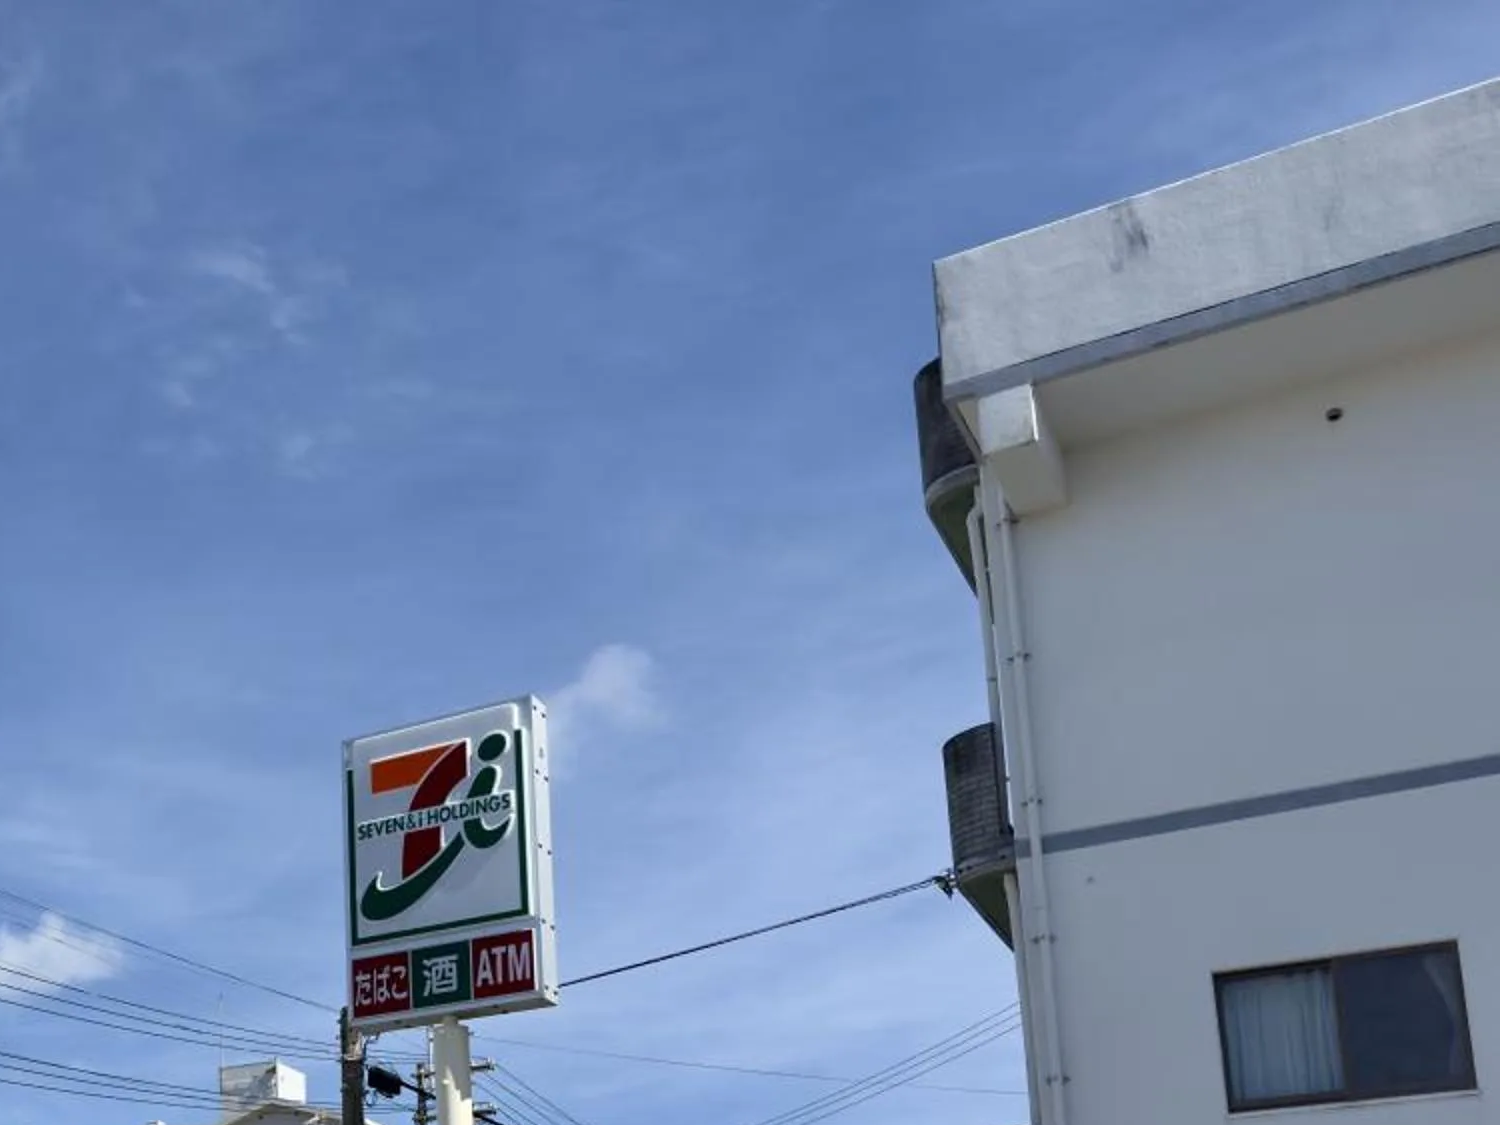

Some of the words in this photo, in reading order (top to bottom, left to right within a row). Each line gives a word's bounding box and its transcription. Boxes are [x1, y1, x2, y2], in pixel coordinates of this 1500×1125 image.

[427, 793, 511, 823] HOLDINGS
[355, 964, 408, 1007] たばこ
[422, 953, 459, 997] 酒
[475, 942, 531, 987] ATM
